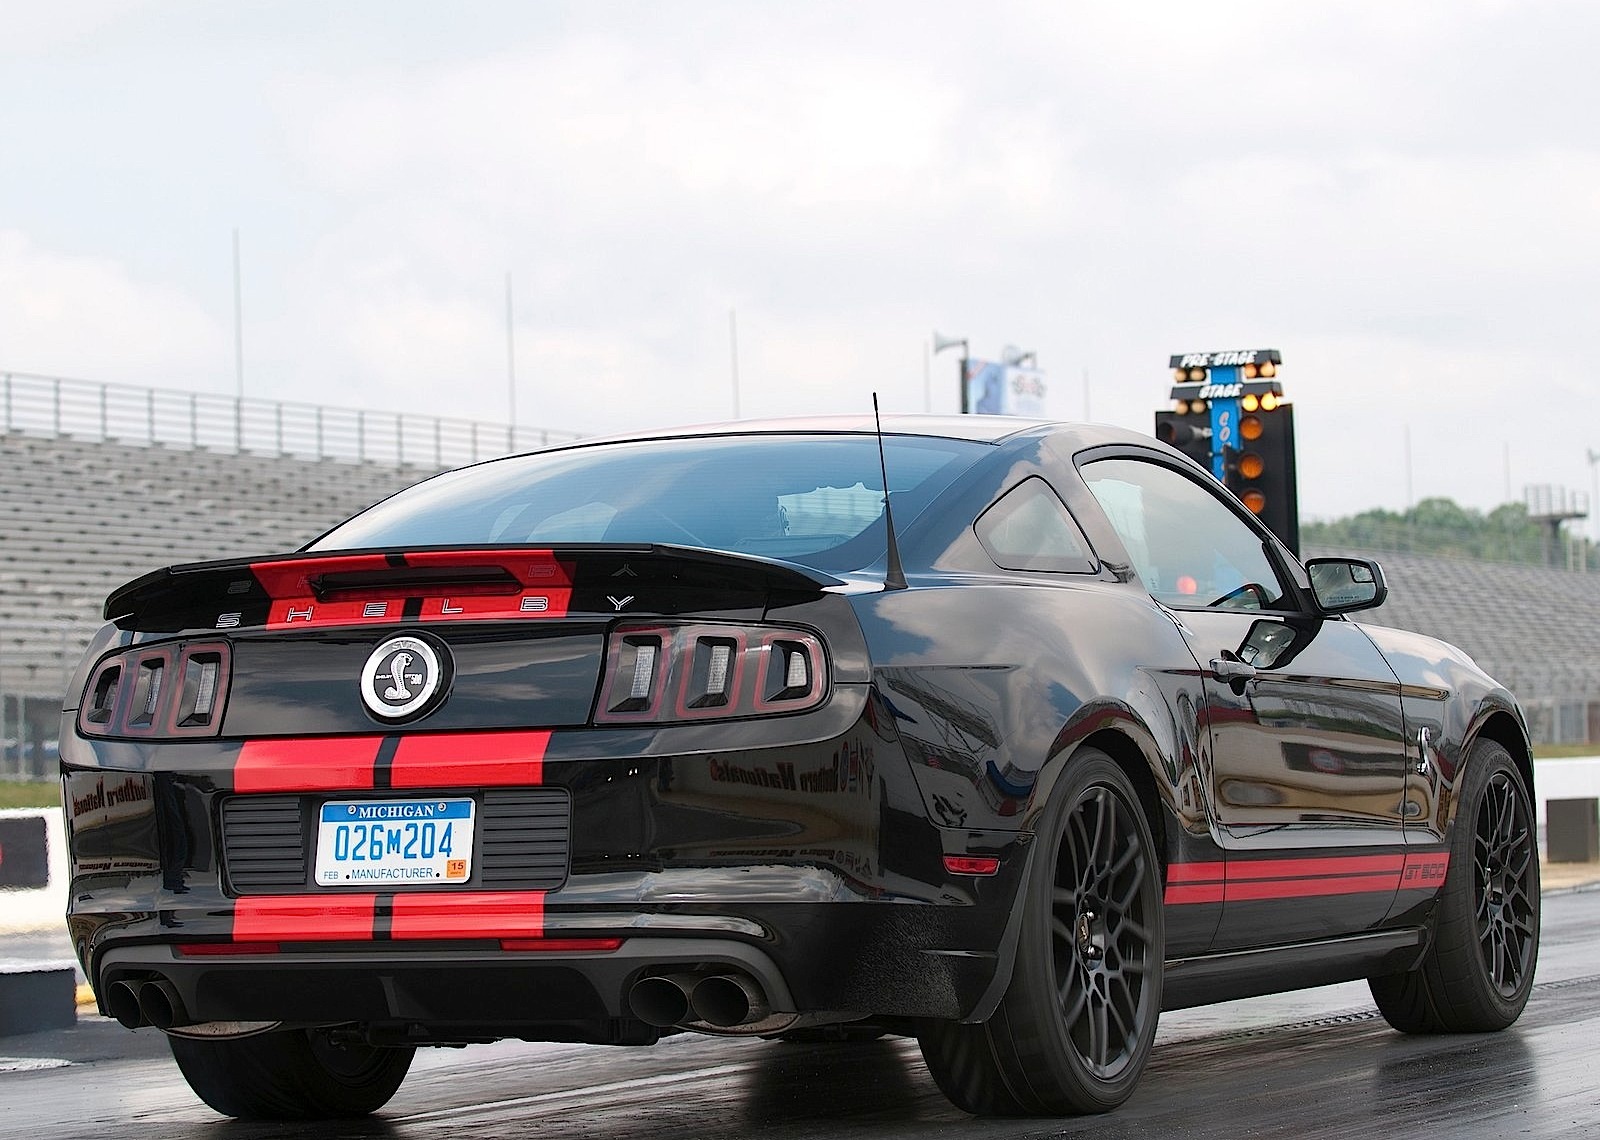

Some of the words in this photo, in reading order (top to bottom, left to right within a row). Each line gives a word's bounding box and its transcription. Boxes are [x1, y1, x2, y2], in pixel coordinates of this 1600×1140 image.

[1180, 351, 1257, 367] PRE-STAGE
[1199, 384, 1243, 399] STAGE
[216, 596, 634, 628] SHELBY
[359, 804, 435, 818] MICHIGAN
[335, 822, 453, 861] 026M204
[323, 871, 339, 880] FEB
[351, 867, 433, 879] MANUFACTURER
[452, 862, 464, 871] 15
